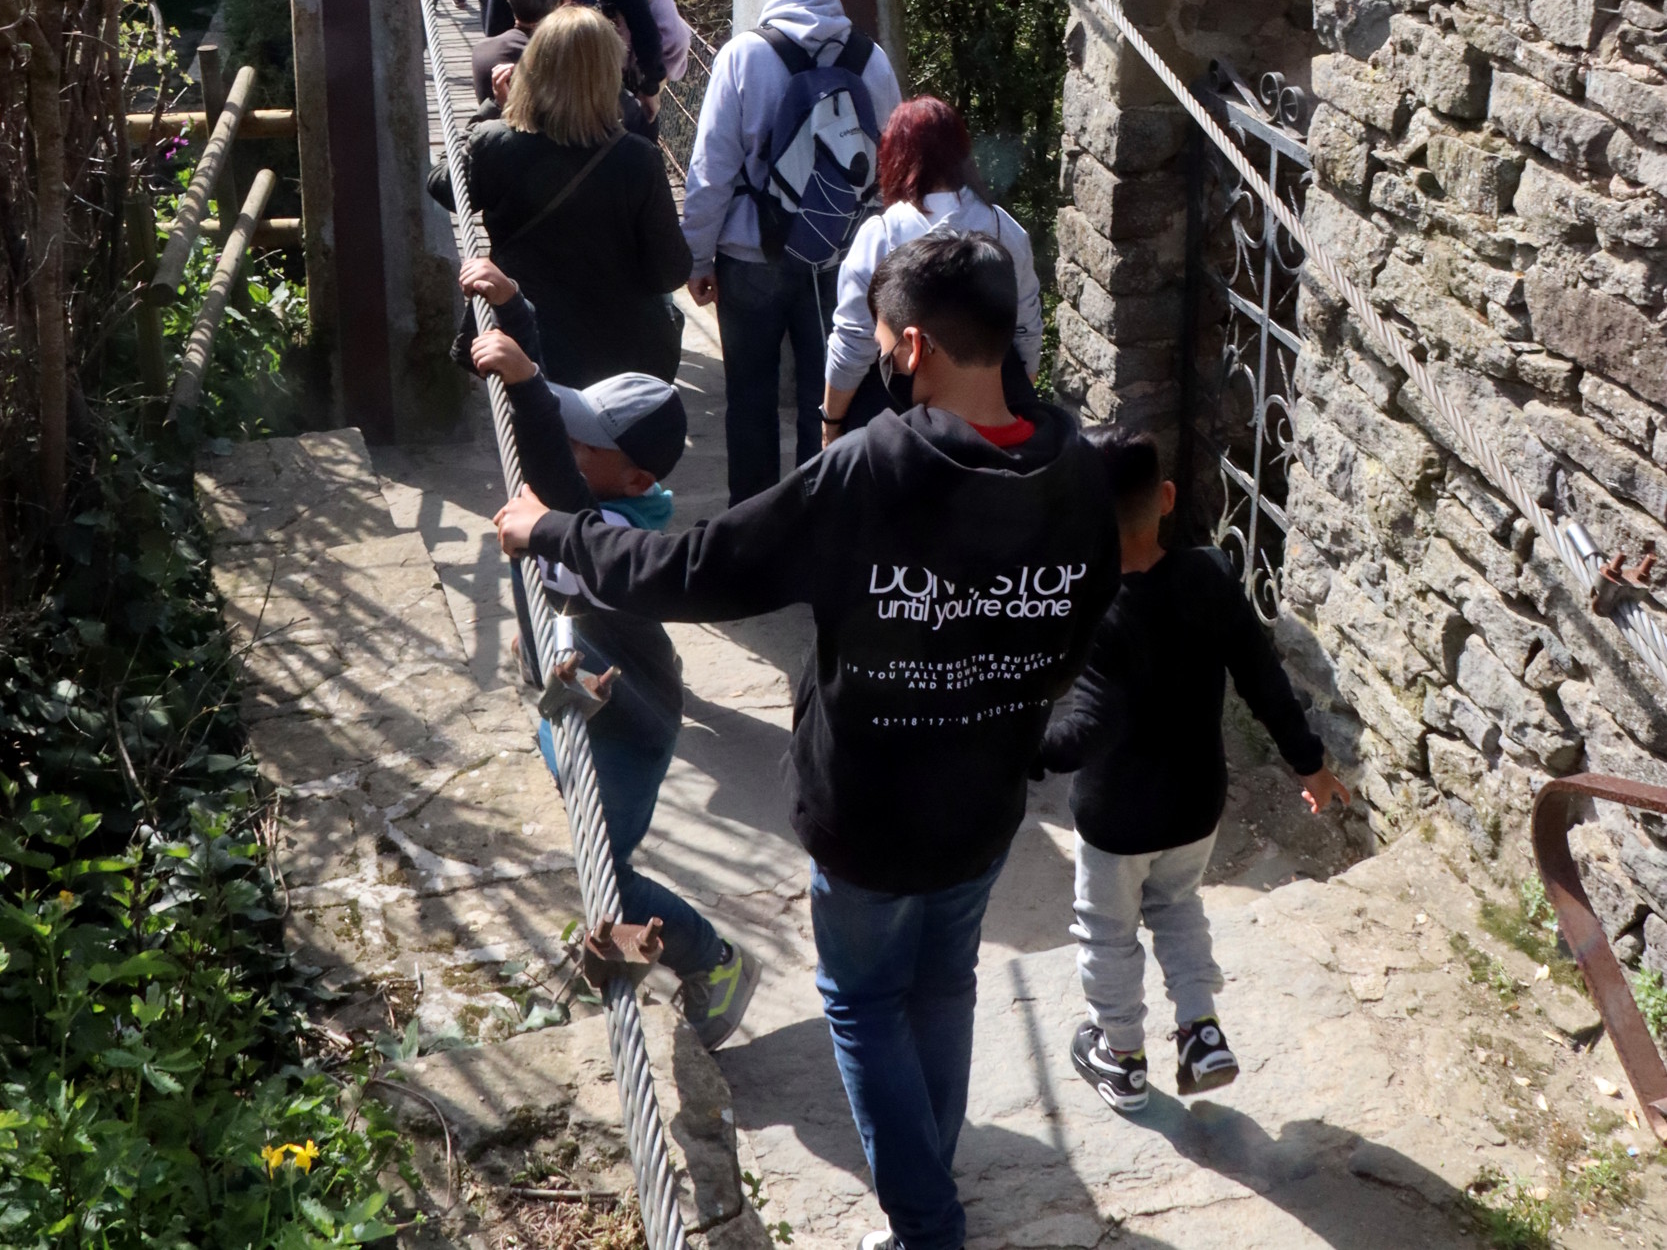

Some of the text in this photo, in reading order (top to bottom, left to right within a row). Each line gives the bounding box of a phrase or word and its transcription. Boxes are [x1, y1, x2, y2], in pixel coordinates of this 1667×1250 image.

[878, 591, 1072, 631] until you're done
[847, 663, 859, 673] IF
[867, 670, 896, 680] YOU
[904, 670, 938, 681] FALL
[991, 662, 1017, 673] GET
[1024, 656, 1053, 672] BACK
[889, 659, 968, 672] CHALLENGE
[971, 653, 996, 664] THE
[907, 671, 1023, 690] AND KEEP GOING
